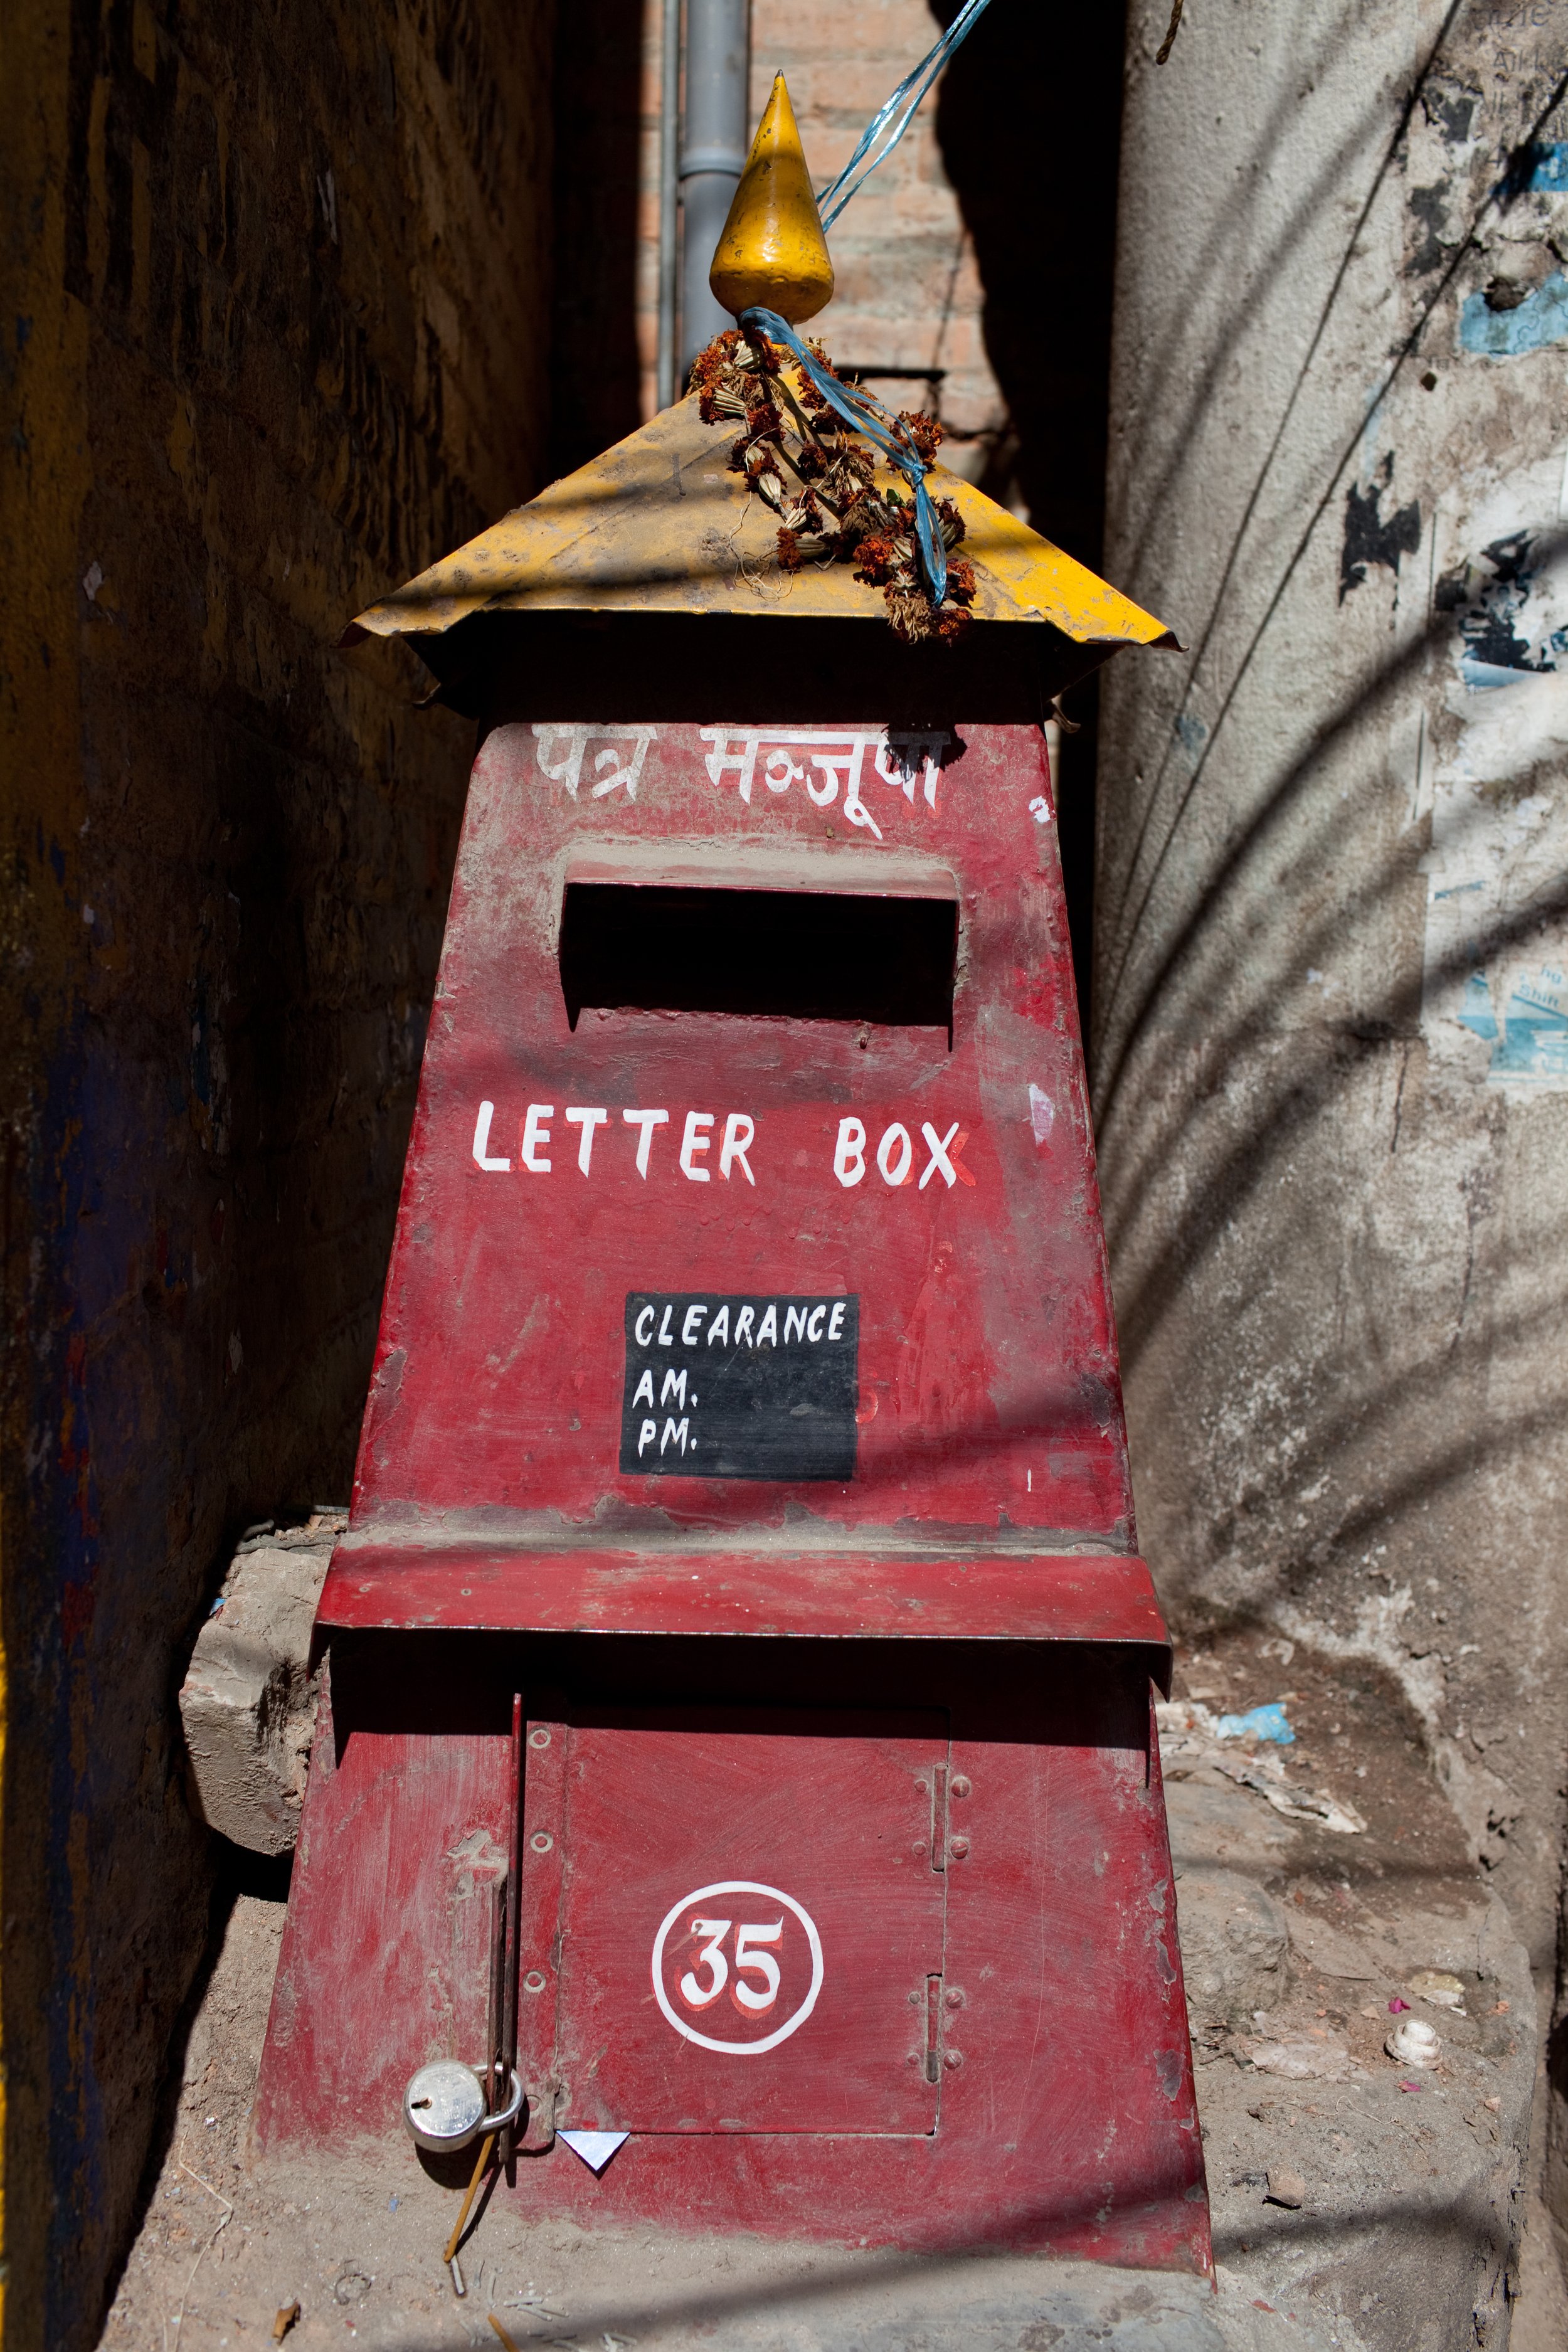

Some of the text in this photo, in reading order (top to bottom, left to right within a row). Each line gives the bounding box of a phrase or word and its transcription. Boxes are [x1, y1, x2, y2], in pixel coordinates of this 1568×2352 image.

[531, 724, 658, 802] पत्र
[472, 1100, 961, 1190] LETTER BOX
[635, 1301, 847, 1348] CLEARANCE
[632, 1369, 699, 1411] AM.
[637, 1417, 698, 1458] PM.
[680, 1915, 785, 2010] 35
